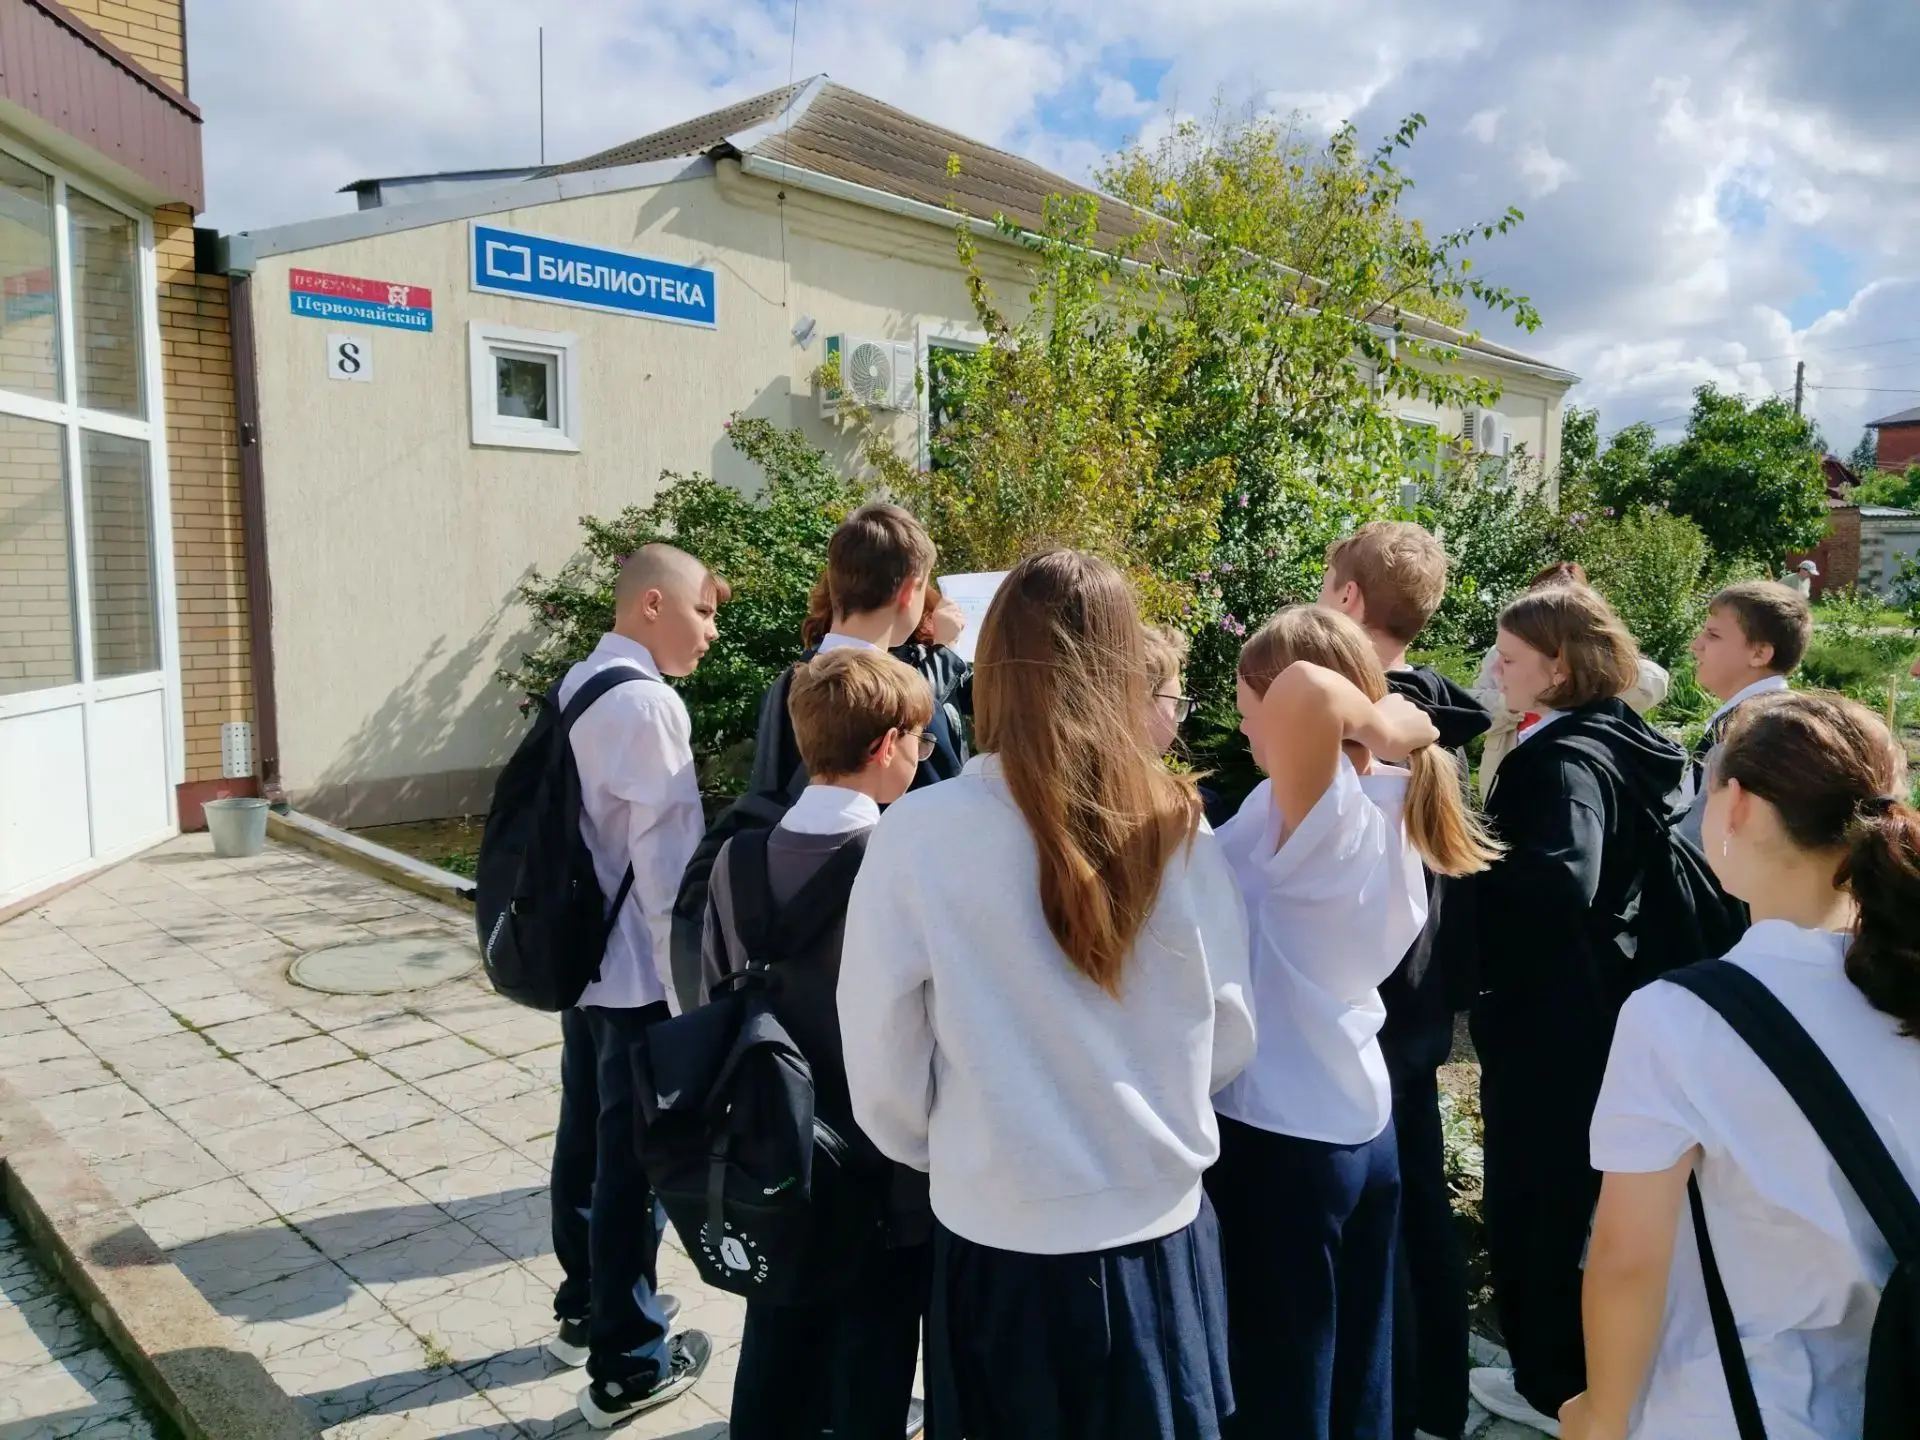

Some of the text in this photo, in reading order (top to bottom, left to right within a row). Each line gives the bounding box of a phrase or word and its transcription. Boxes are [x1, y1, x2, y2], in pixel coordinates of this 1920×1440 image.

[538, 255, 706, 307] БИБЛИОТЕКА
[296, 295, 427, 326] Первомайский
[338, 342, 361, 373] 8
[740, 1232, 757, 1248] AS
